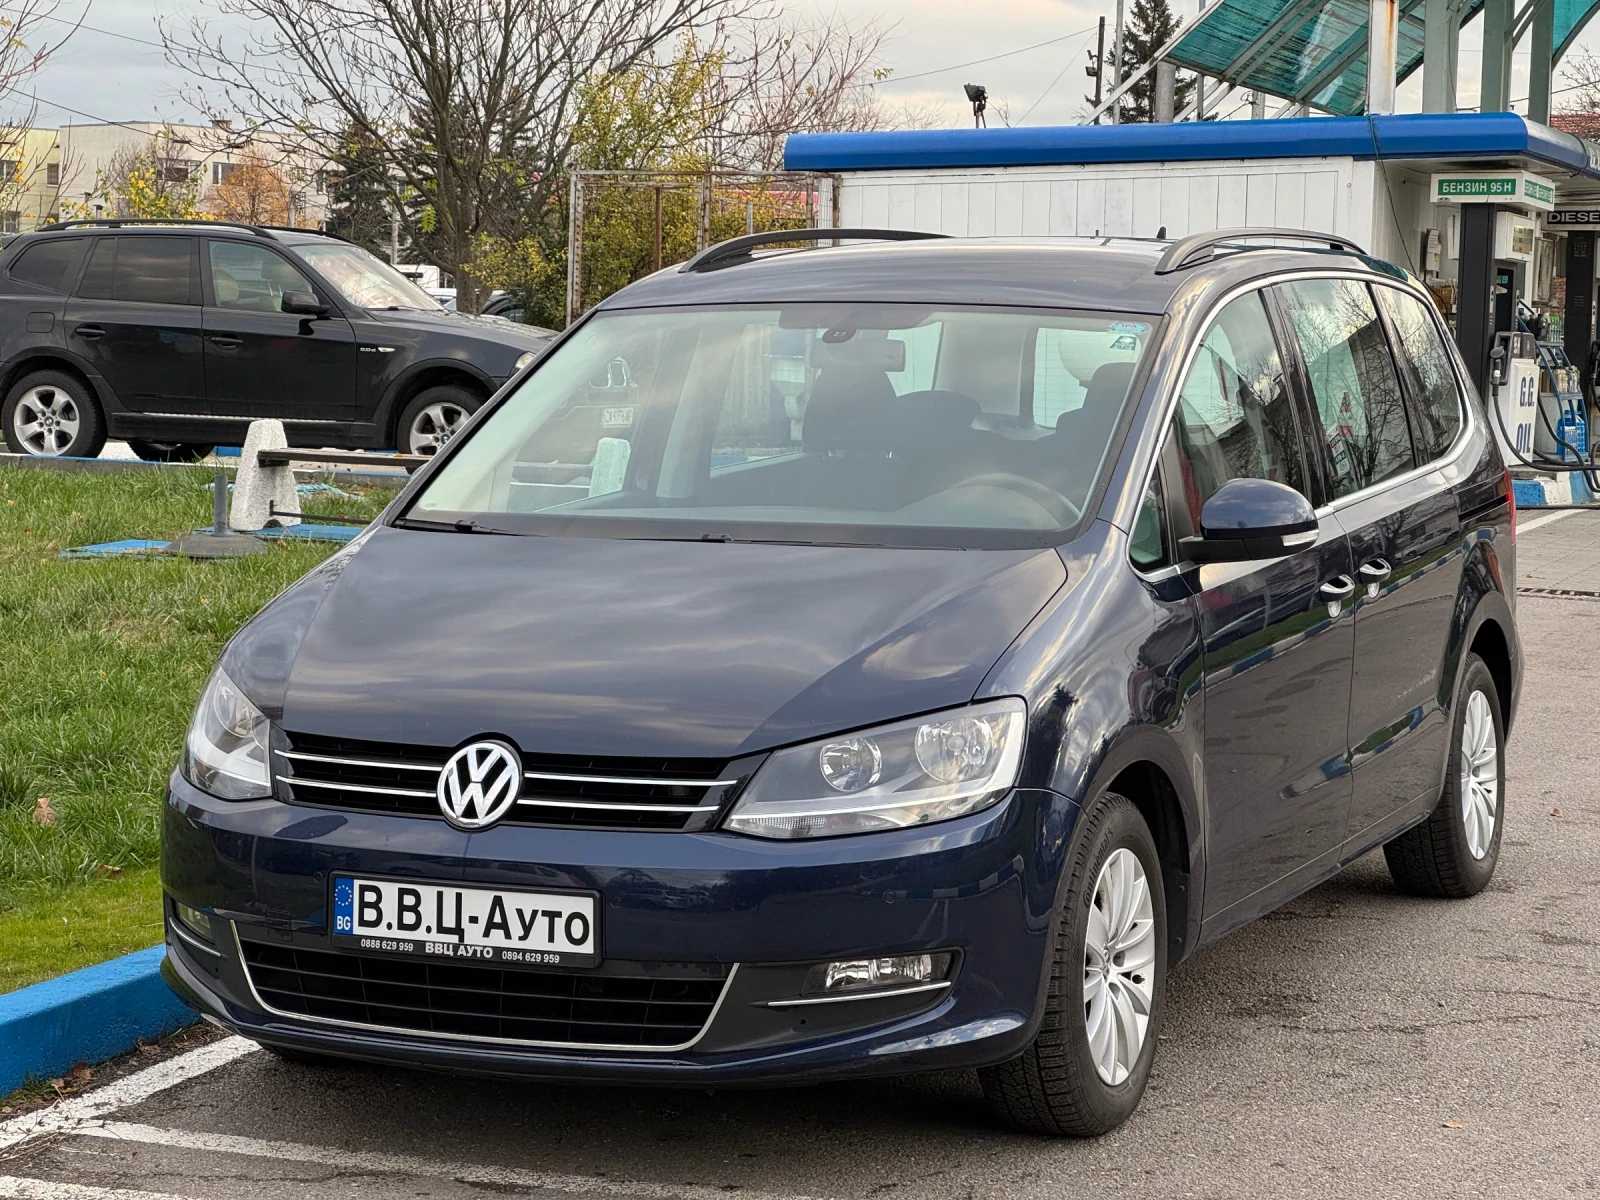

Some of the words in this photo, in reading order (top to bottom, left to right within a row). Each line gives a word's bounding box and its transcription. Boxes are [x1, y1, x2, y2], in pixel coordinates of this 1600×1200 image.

[1442, 182, 1487, 193] БЕНЗИН
[1516, 422, 1532, 454] OIL
[336, 915, 351, 931] BG
[360, 937, 381, 950] 0888
[382, 939, 397, 951] 629
[399, 941, 414, 952] 959
[425, 942, 454, 956] ВВЦ
[457, 945, 493, 959] АУТО
[502, 950, 524, 961] 0894
[525, 952, 542, 963] 629
[543, 954, 560, 964] 959
